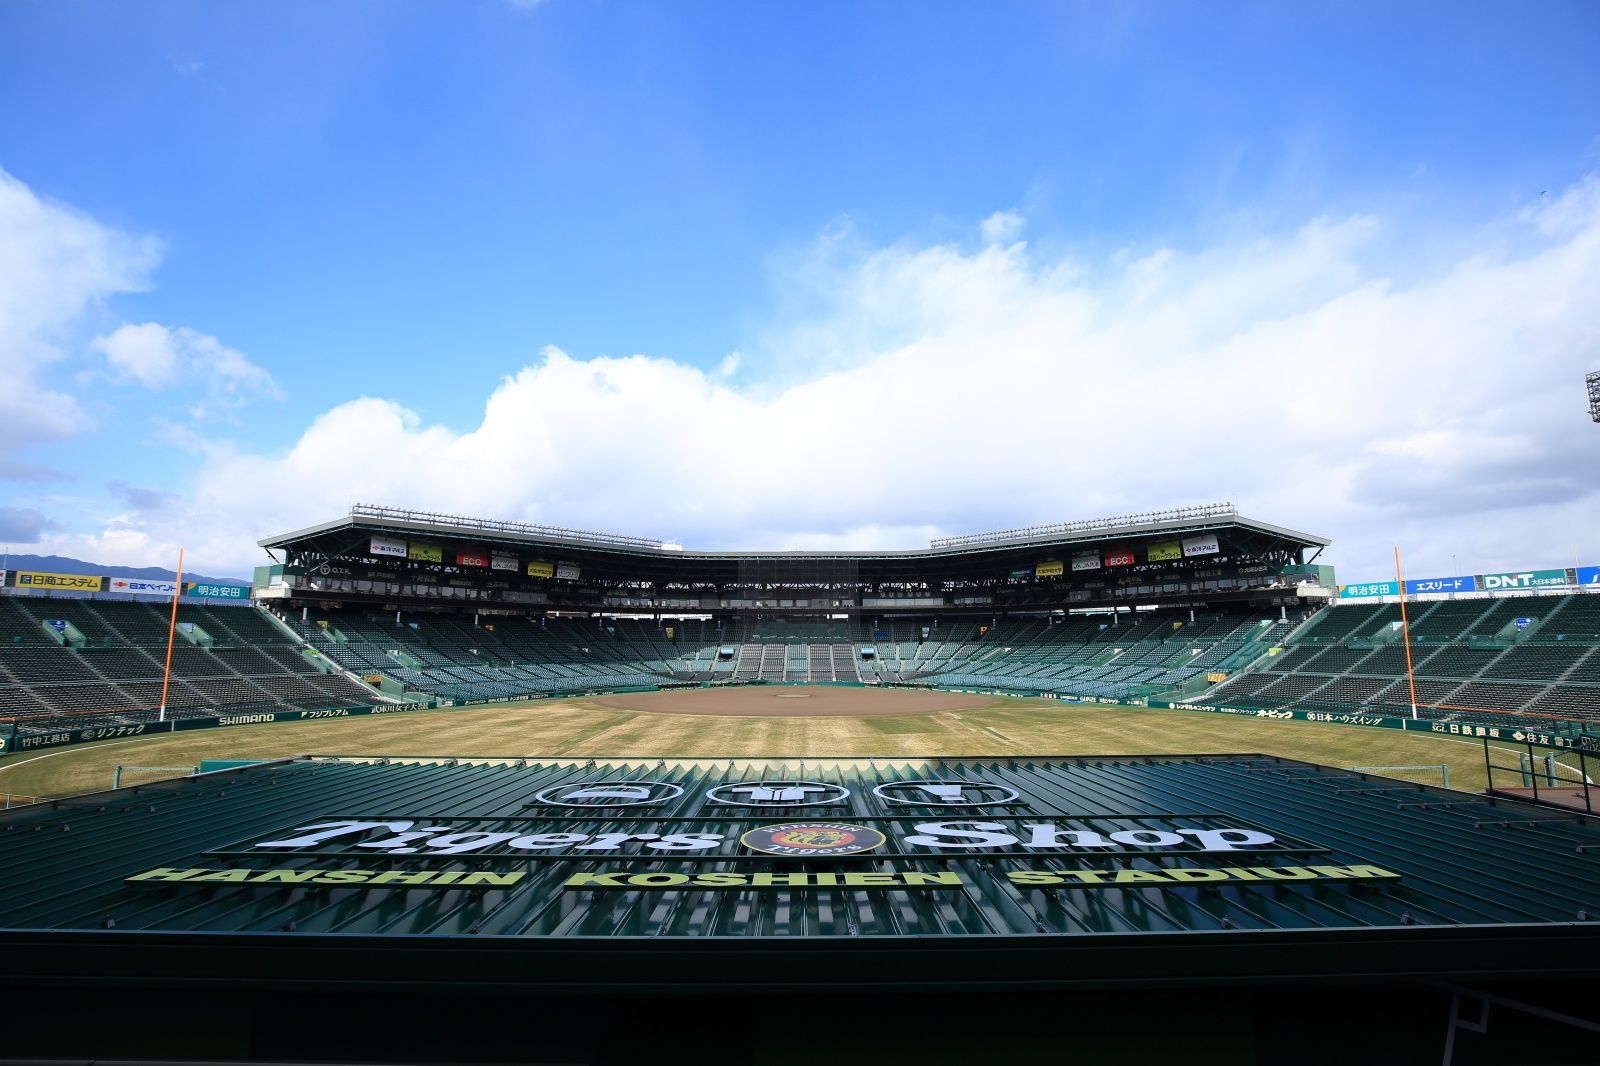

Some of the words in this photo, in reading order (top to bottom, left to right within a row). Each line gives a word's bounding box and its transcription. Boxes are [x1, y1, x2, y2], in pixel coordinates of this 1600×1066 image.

[463, 557, 482, 566] ECC
[1110, 556, 1128, 565] ECC
[33, 575, 98, 588] 日商エステム
[1416, 580, 1463, 591] エスリード
[1485, 573, 1534, 588] DNT
[129, 582, 177, 592] 日本ペイント
[198, 585, 240, 597] 明治安田
[1348, 584, 1390, 596] 明治安田
[309, 709, 349, 718] フジプレアム
[1176, 703, 1216, 712] レンタルのニッケン
[219, 714, 275, 726] SHIMANO
[1256, 709, 1293, 719] オービック
[1316, 713, 1383, 726] 日本ハウズイング
[97, 724, 145, 738] リンテック
[1450, 724, 1499, 738] 日鉄鋼板
[21, 732, 70, 748] 竹中工務店
[762, 823, 863, 833] HANSHIN
[255, 820, 724, 854] Tigers
[904, 821, 1275, 851] Shop
[764, 844, 863, 855] Tigers
[131, 867, 527, 884] HANSHIN
[567, 871, 960, 886] KOSHIEN
[1007, 865, 1401, 884] STADIUM
